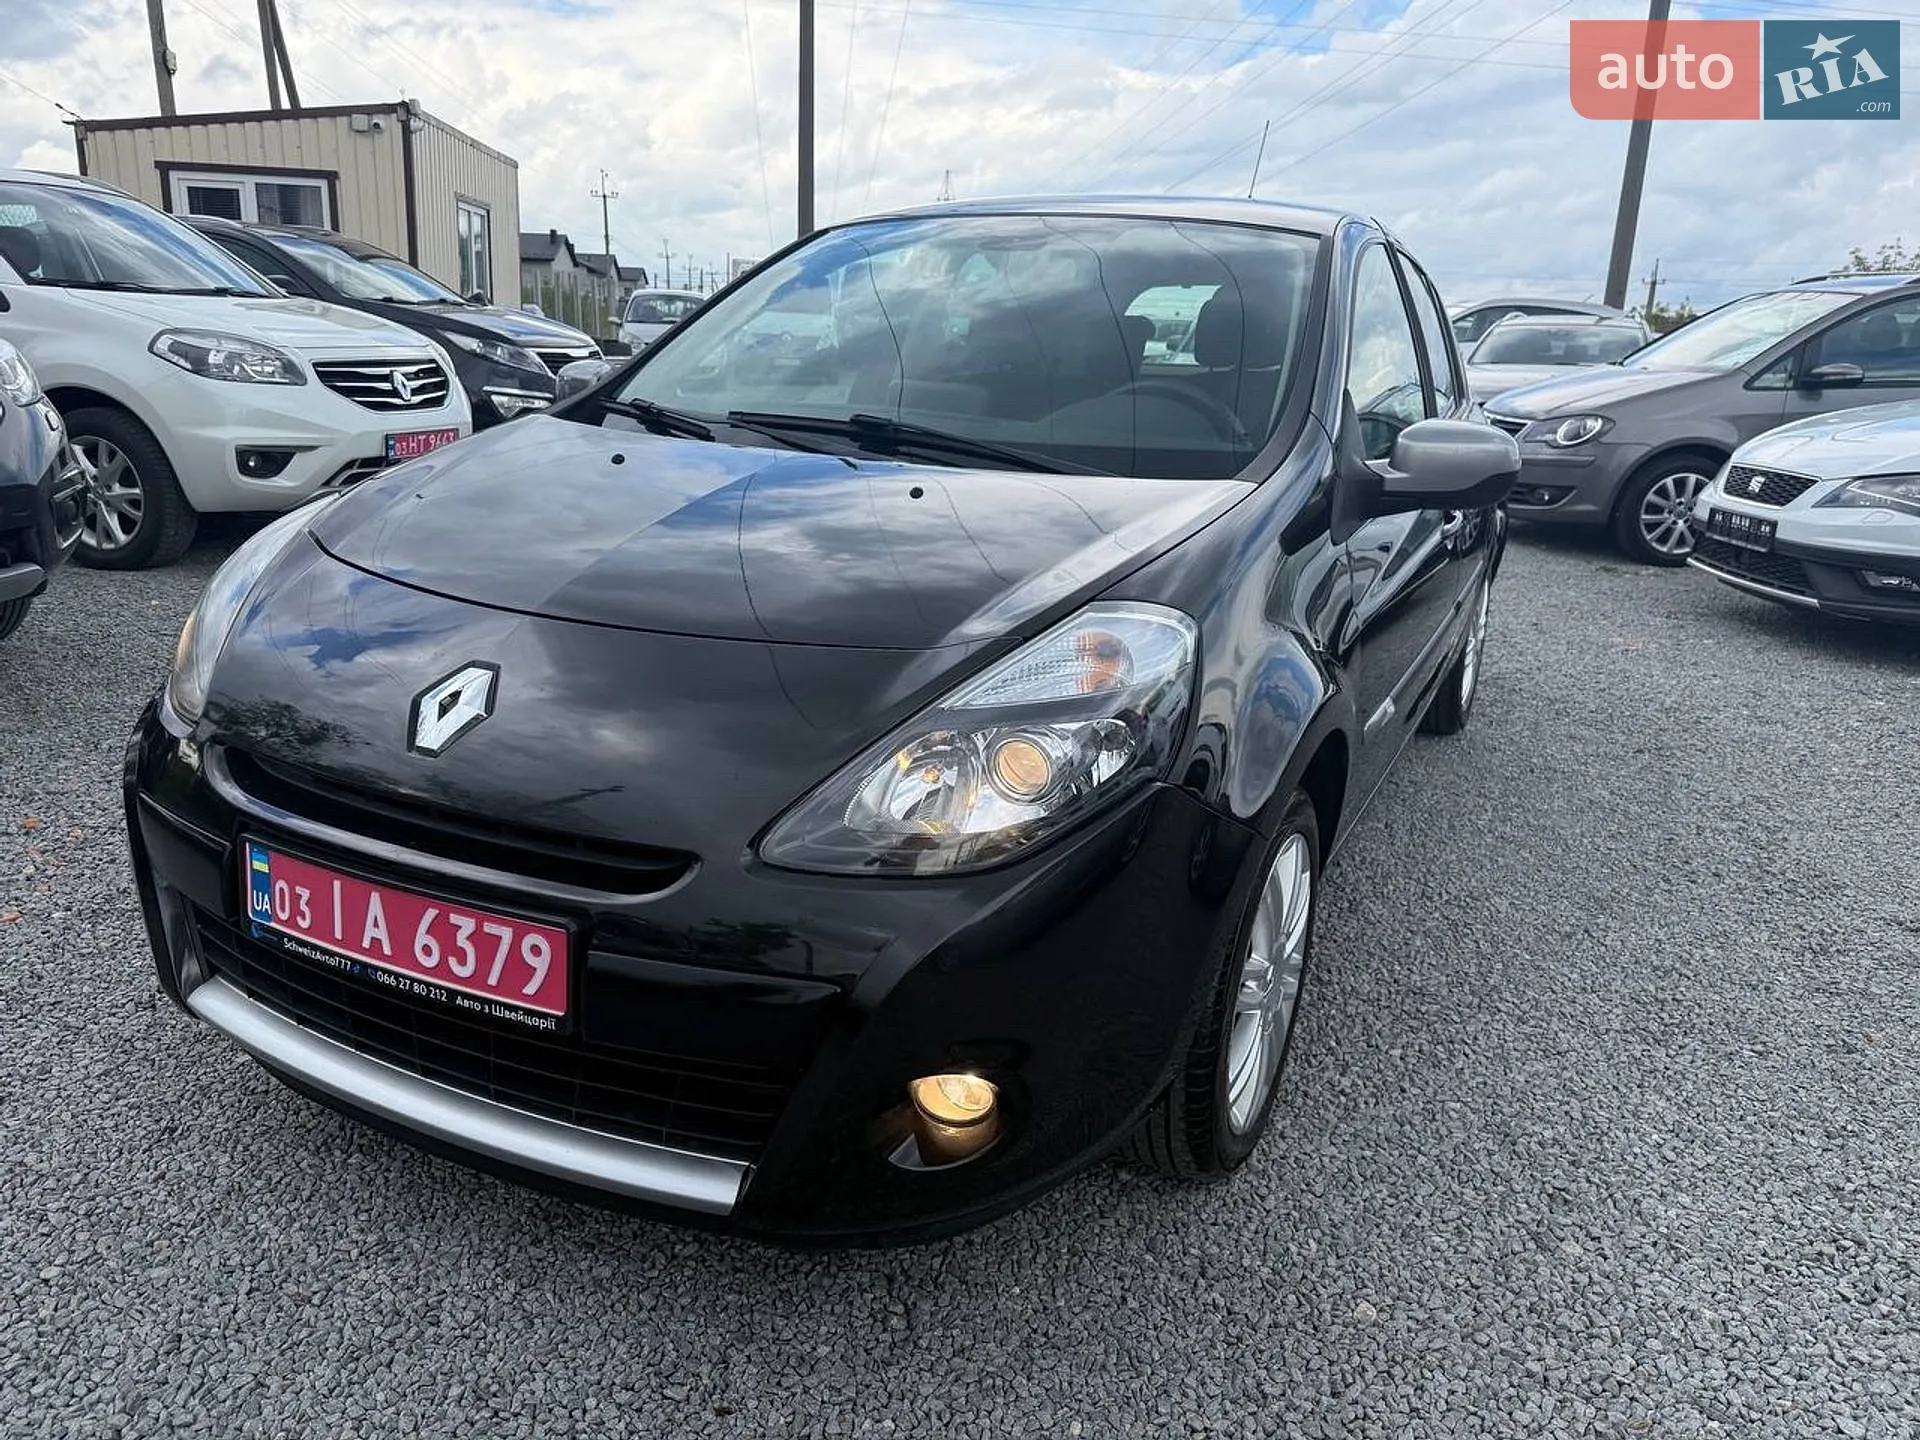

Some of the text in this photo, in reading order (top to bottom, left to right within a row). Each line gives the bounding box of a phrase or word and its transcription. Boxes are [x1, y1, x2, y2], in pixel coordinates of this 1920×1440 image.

[253, 889, 271, 914] UA
[274, 879, 552, 996] 03 IA 6379
[376, 971, 397, 986] 066
[399, 978, 410, 991] 27
[413, 982, 427, 996] 80
[430, 987, 448, 1002] 212
[455, 995, 481, 1011] Авто
[491, 1003, 556, 1030] Швейцарії
